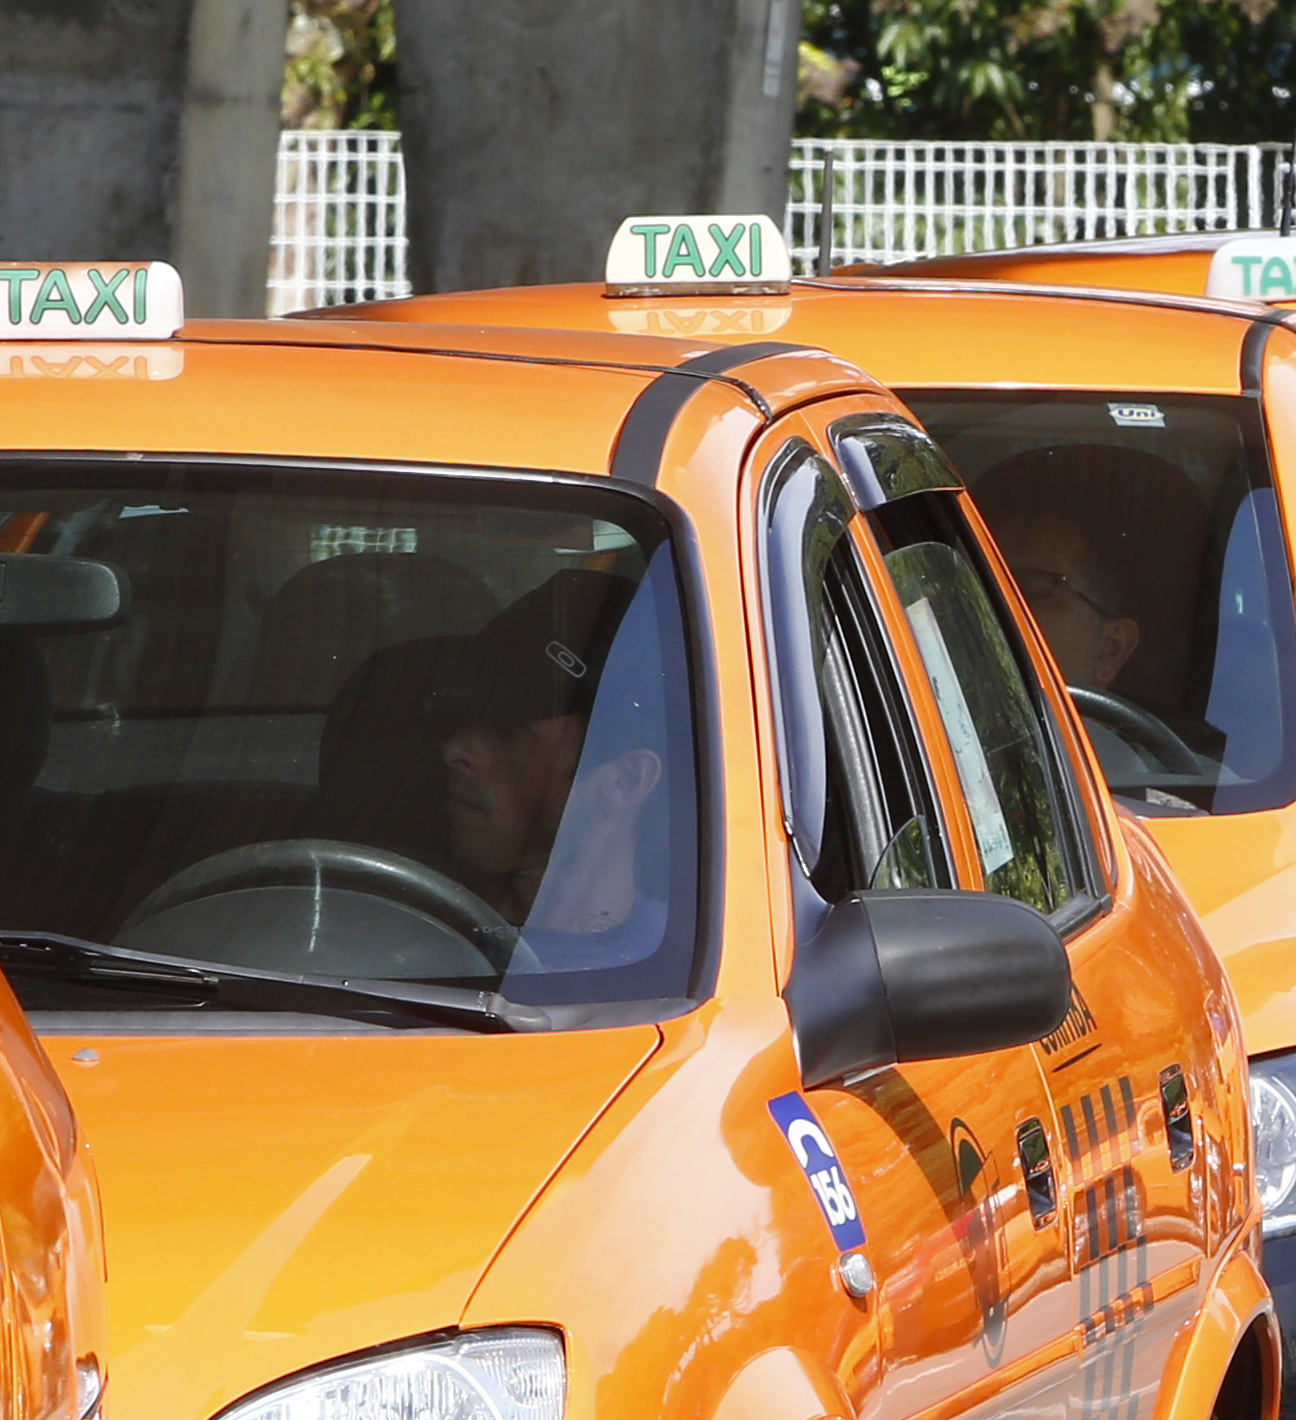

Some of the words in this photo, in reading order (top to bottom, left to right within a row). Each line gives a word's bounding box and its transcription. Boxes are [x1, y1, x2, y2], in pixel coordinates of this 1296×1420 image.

[630, 223, 762, 278] TAXI
[1118, 409, 1155, 418] Uni
[810, 1166, 856, 1226] 156
